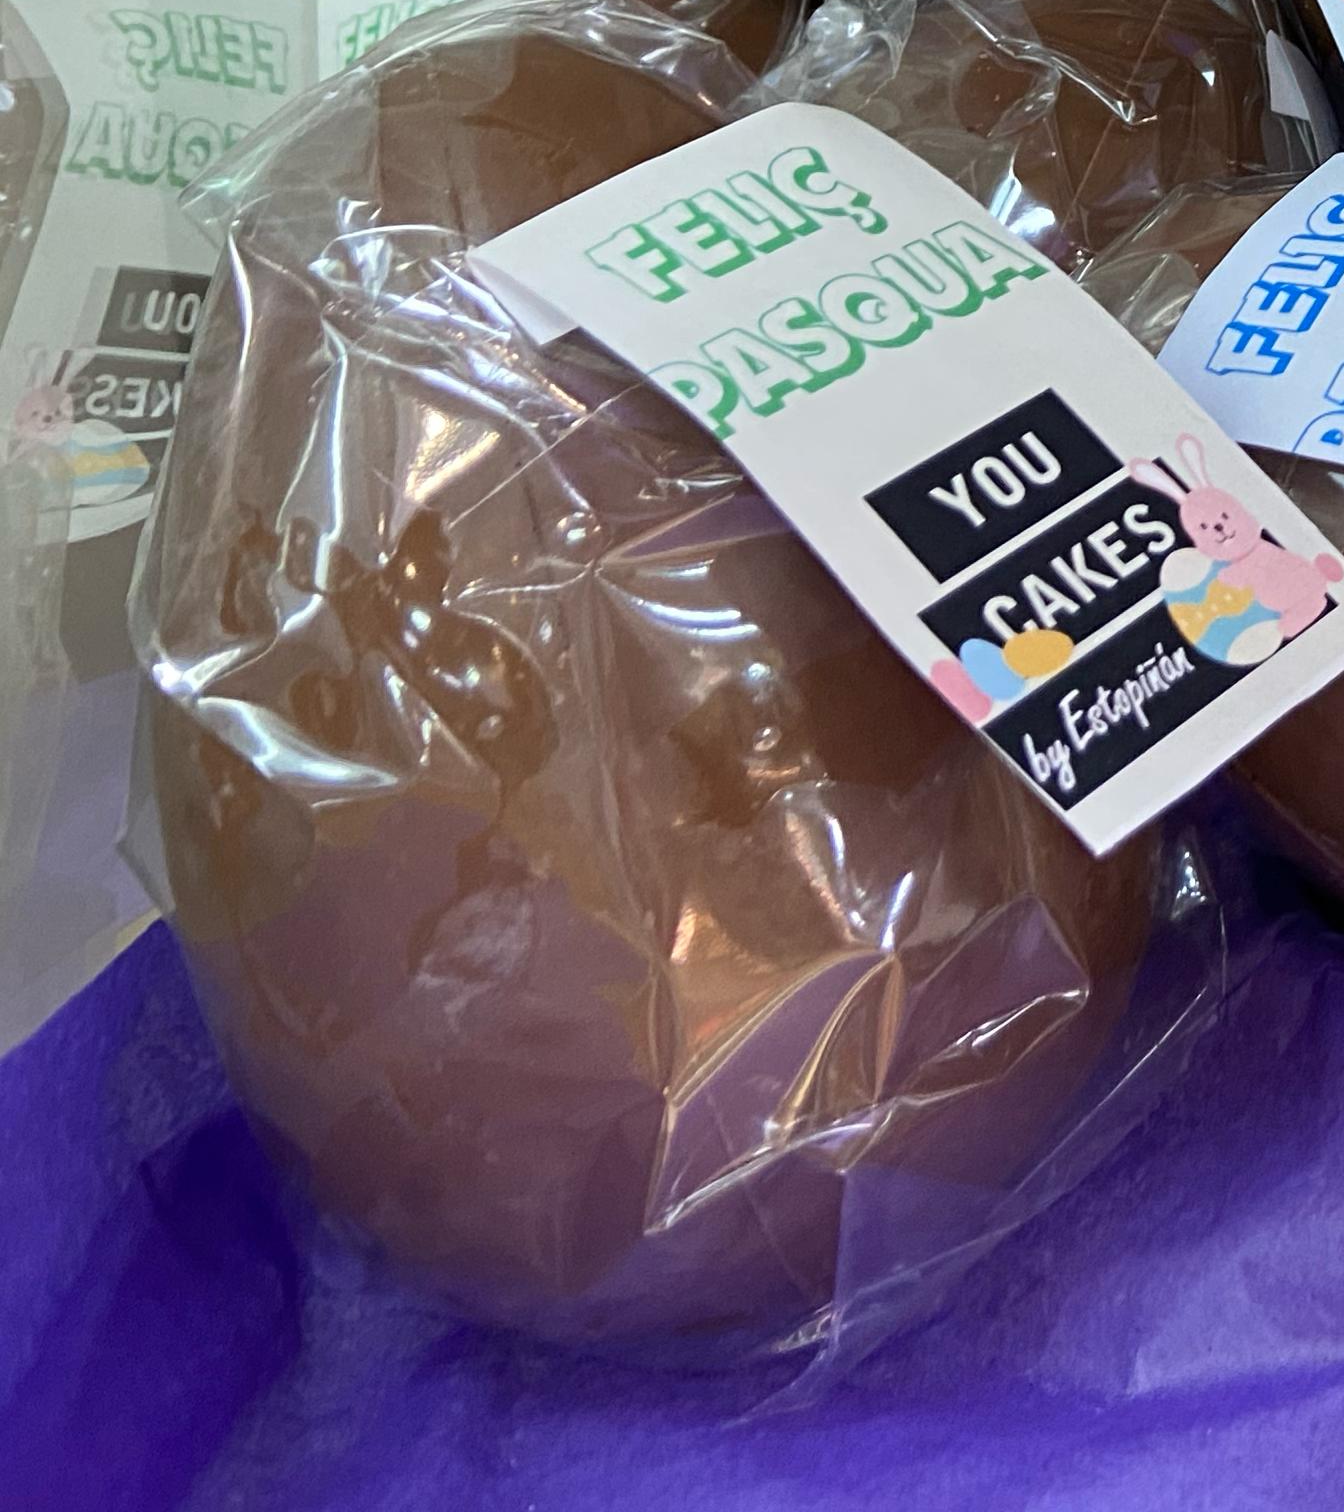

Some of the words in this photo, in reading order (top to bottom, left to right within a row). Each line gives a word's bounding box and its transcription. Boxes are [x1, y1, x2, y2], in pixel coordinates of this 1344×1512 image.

[586, 146, 888, 303] FELIÇ
[650, 220, 1050, 440] PASQUA
[929, 430, 1060, 531] YOU
[980, 502, 1175, 644] CAKES
[1023, 733, 1078, 791] by
[1057, 643, 1192, 750] Estopiñán
